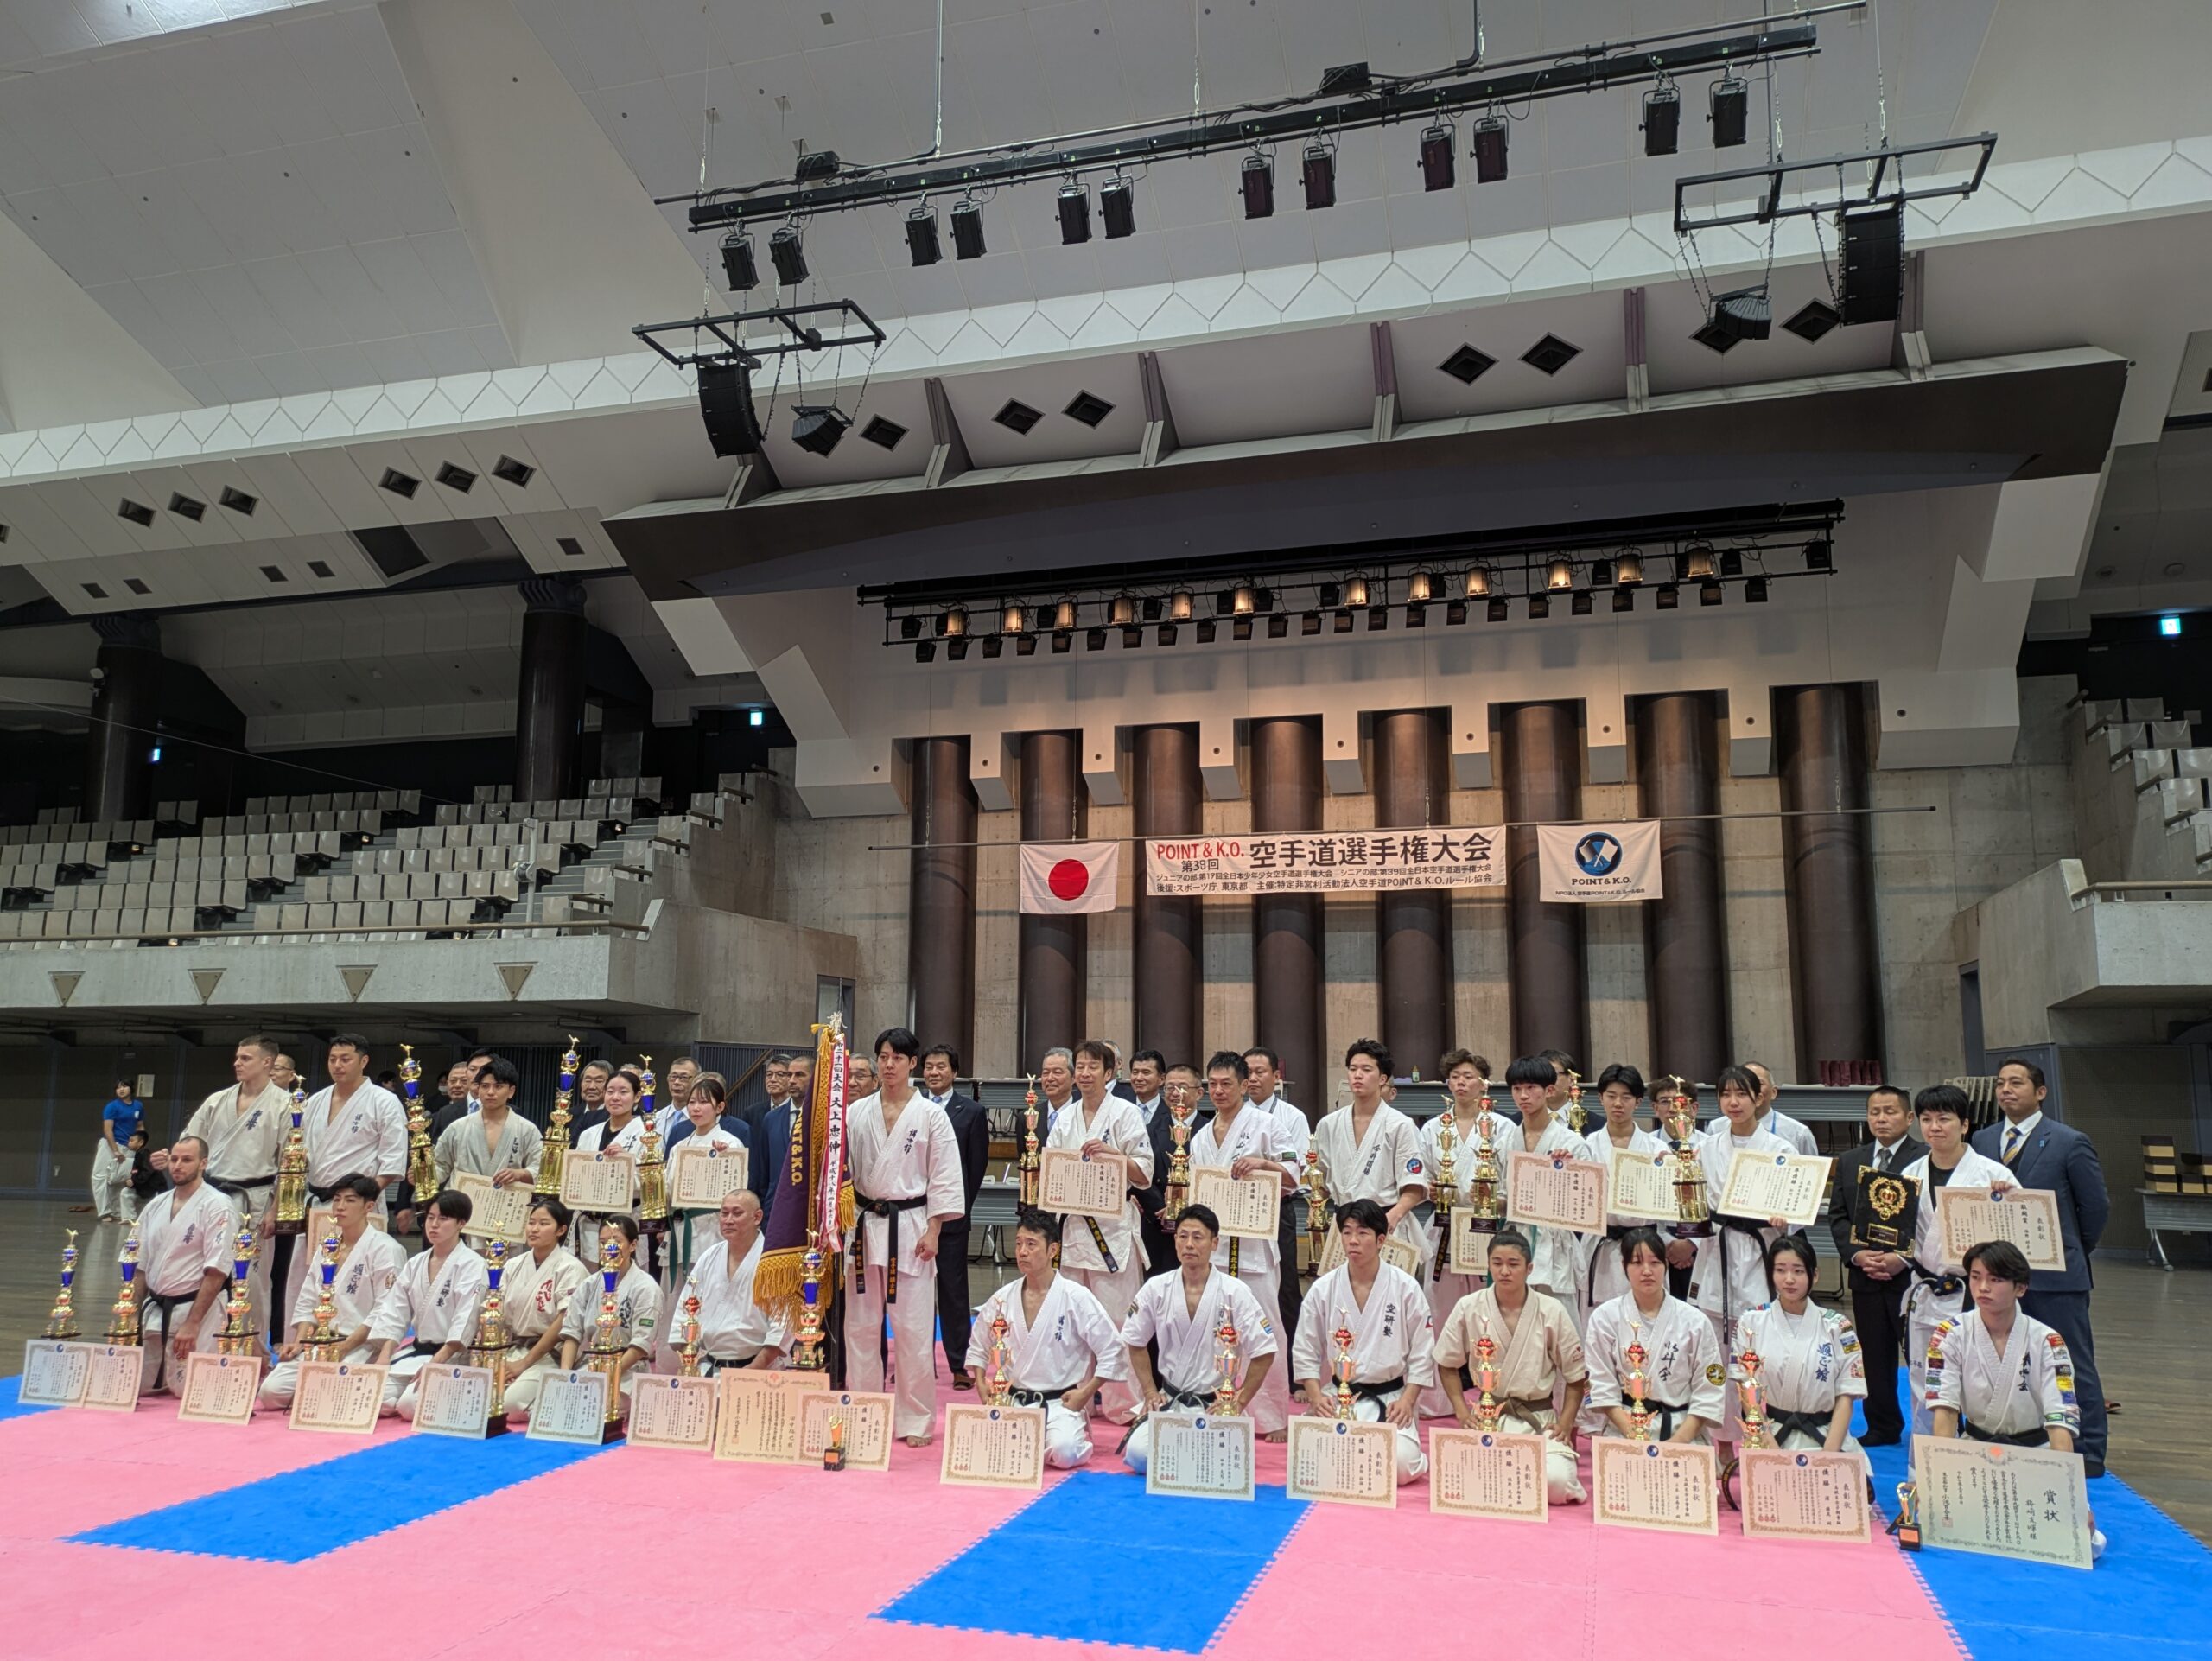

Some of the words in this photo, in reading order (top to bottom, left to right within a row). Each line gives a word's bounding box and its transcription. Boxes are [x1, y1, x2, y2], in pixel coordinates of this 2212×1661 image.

[1157, 843, 1199, 860] POINT
[1202, 842, 1213, 858] &
[1217, 841, 1244, 857] K.O.
[1249, 832, 1492, 869] 空手道選手権大会
[1181, 858, 1219, 873] 第39回
[1221, 881, 1249, 891] 東京都
[791, 1144, 803, 1155] &
[791, 1157, 803, 1186] K.O.
[1383, 1303, 1395, 1337] 空研塾
[2043, 1488, 2060, 1522] 賞状
